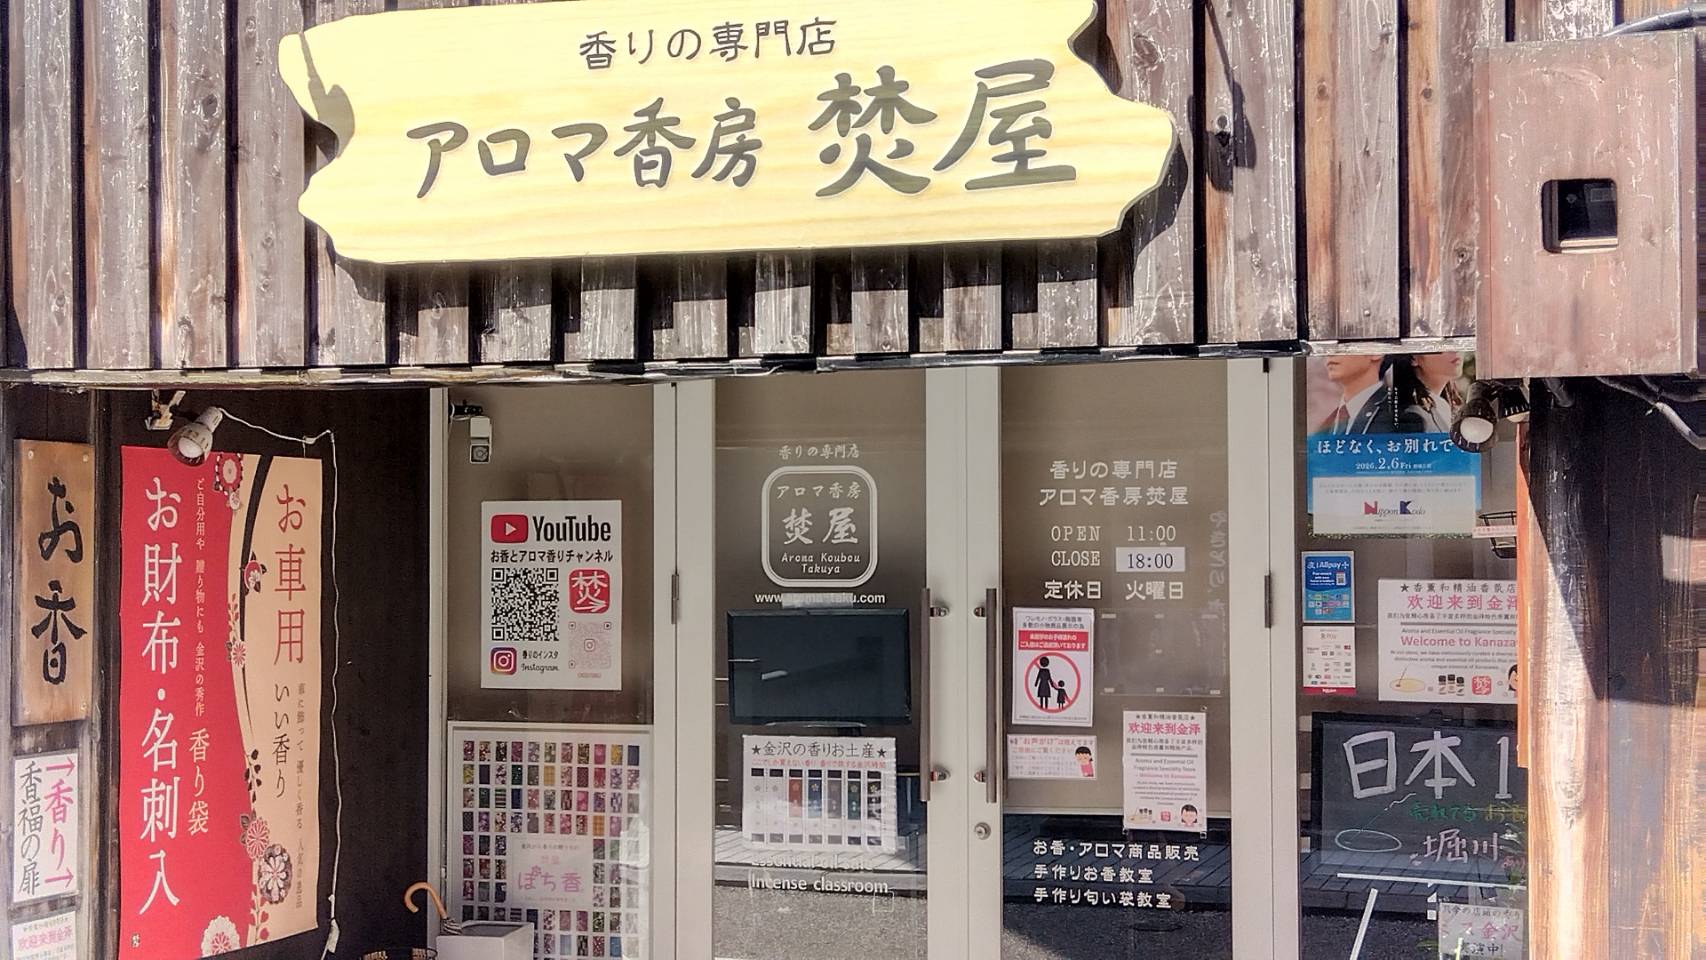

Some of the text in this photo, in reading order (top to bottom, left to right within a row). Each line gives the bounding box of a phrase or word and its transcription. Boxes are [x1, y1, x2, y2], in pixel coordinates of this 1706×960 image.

[579, 17, 837, 70] 香りの専門店
[407, 58, 1077, 199] アロマ香房 焚屋
[779, 443, 860, 460] 香りの専門店
[1318, 438, 1465, 454] ほどなく、お別れで
[1050, 459, 1178, 480] 香りの専門店
[777, 481, 863, 500] アロマ香房
[1039, 486, 1189, 506] アロマ香房焚屋
[1364, 501, 1399, 517] Nippon
[532, 515, 612, 542] YouTube
[782, 507, 859, 545] 焚屋
[1051, 525, 1176, 542] OPEN 11:00
[490, 549, 614, 564] お香とアロマ香りチャンネル
[821, 552, 861, 563] Koubou
[1051, 551, 1174, 569] CLOSE 18:00
[801, 563, 841, 575] Takuya
[31, 476, 88, 685] お香
[1044, 580, 1184, 601] 定休日 火曜日
[272, 483, 307, 799] お車用 いい香り
[1401, 636, 1456, 647] Welcome
[1460, 637, 1471, 647] to
[521, 663, 560, 674] Instagram
[138, 476, 183, 916] お財布・名刺入
[764, 741, 876, 759] 金沢の香りお土産
[188, 728, 211, 836] 香り袋
[44, 778, 73, 870] 香り
[1033, 840, 1200, 861] お香・アロマ商品販売
[1423, 828, 1499, 863] 堀川
[751, 873, 888, 893] Incense classroom
[1034, 864, 1154, 884] 手作りお香教室
[1033, 887, 1172, 909] 手作り匂い袋教室
